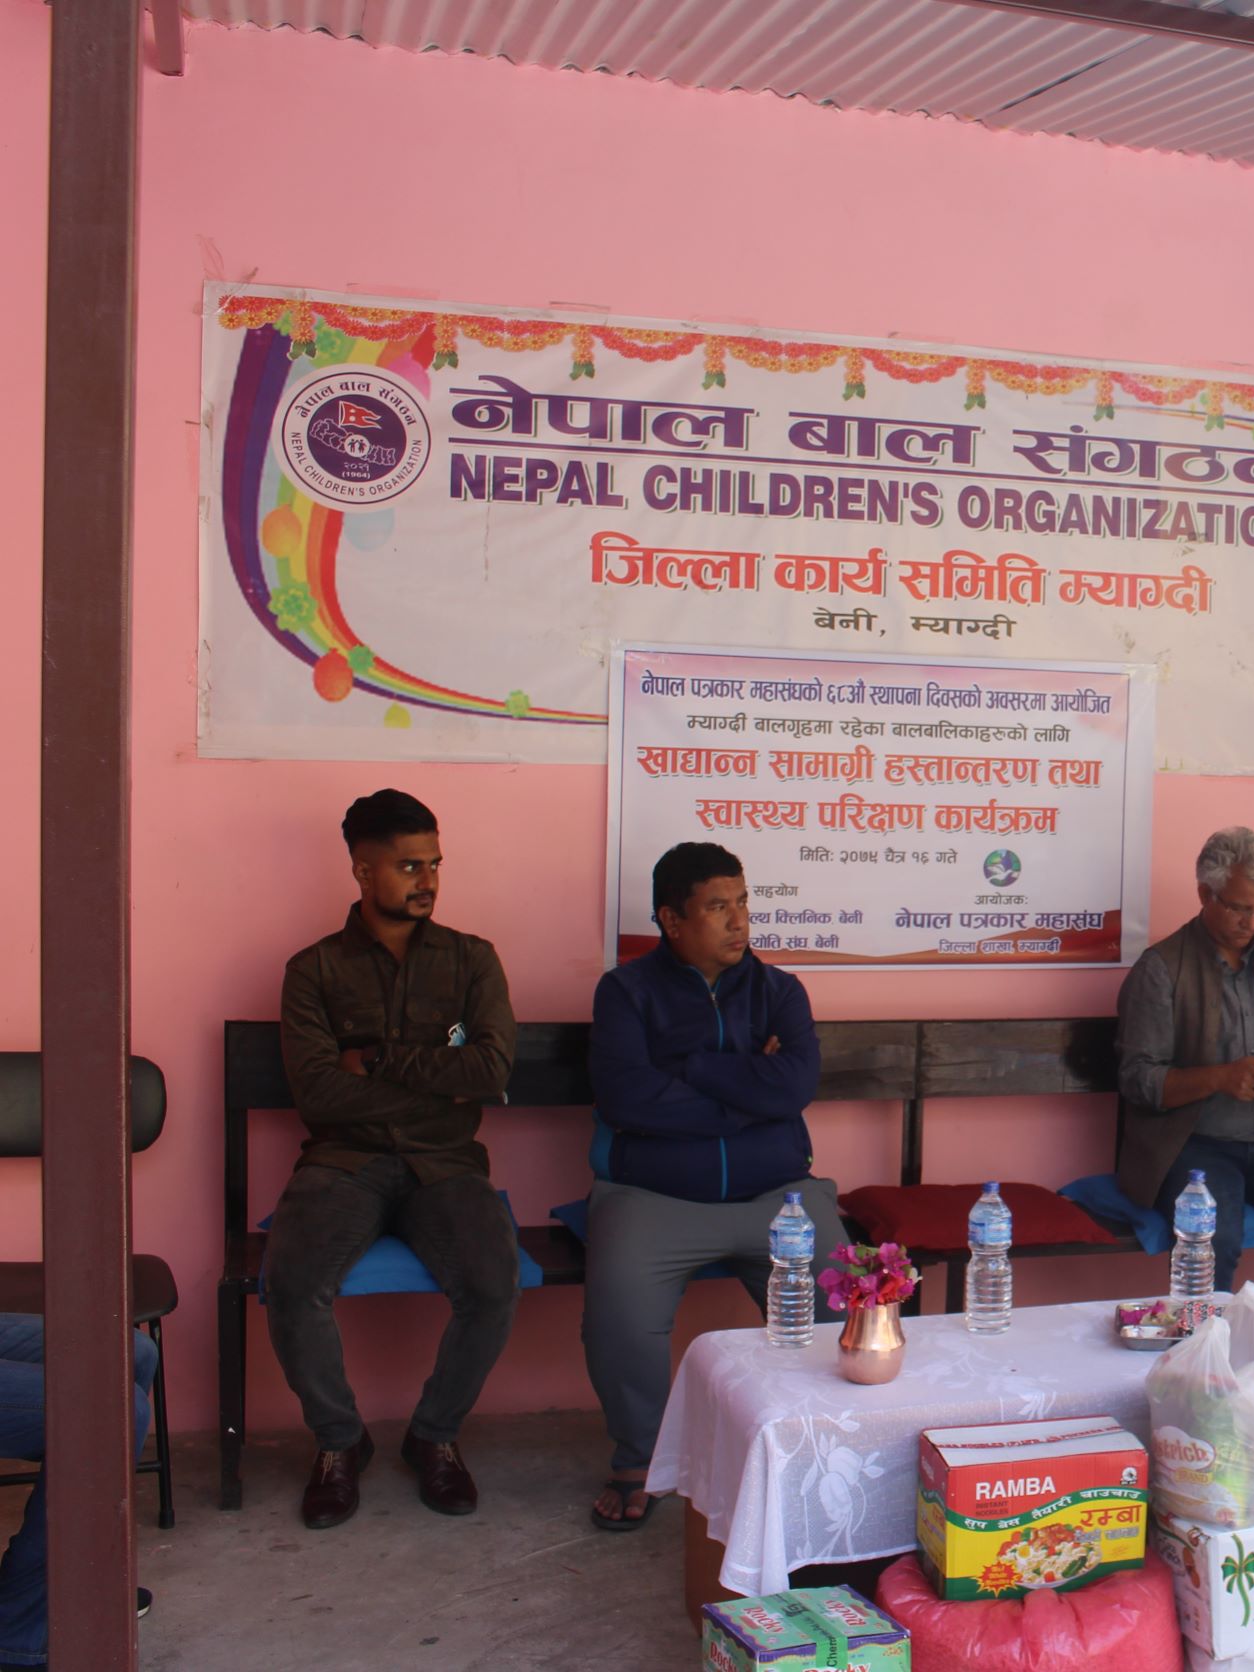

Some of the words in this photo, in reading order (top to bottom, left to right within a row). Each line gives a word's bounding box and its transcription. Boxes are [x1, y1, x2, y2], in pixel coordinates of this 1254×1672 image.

[449, 375, 754, 450] नेपाल
[788, 409, 982, 465] बाल
[291, 432, 306, 466] NEPAL
[304, 465, 366, 497] CHILDREN'S
[369, 439, 422, 496] ORGANIZATION
[342, 472, 371, 480] (1964)
[449, 452, 624, 509] NEPAL
[642, 464, 943, 528] CHILDREN'S
[590, 531, 761, 592] जिल्ला
[773, 547, 888, 599] कार्य
[899, 550, 1047, 607] समिति
[1058, 565, 1214, 614] म्याग्दी
[813, 607, 887, 637] बेनी,
[910, 614, 1017, 640] म्याग्दी
[641, 670, 685, 697] नेपाल
[691, 678, 746, 700] पत्रकार
[750, 677, 823, 702] महासंघको
[870, 685, 922, 706] स्थापना
[926, 682, 982, 709] दिवसको
[986, 690, 1047, 712] अवसरमा
[1051, 688, 1112, 714] आयोजित
[687, 713, 747, 733] म्याग्दी
[753, 717, 833, 738] बालगृहमा
[840, 717, 885, 738] रहेका
[1034, 724, 1072, 743] लागि
[637, 746, 759, 778] खाद्यान्न
[769, 744, 876, 784] सामाग्री
[884, 754, 1040, 786] हस्तान्तरण
[1048, 759, 1103, 788] तथा
[696, 799, 808, 831] स्वास्थ्य
[817, 793, 926, 835] परिक्षण
[935, 798, 1060, 835] कार्यक्रम
[884, 847, 906, 863] चैत्र
[911, 851, 930, 864] १६
[935, 848, 958, 864] गते
[753, 883, 798, 898] सहयोग
[839, 909, 864, 924] बेनी
[895, 908, 952, 929] नेपाल
[959, 912, 1028, 930] पत्रकार
[1035, 909, 1103, 930] महासंघ
[815, 934, 840, 948] बेनी
[939, 938, 976, 953] जिल्ला
[1019, 938, 1060, 953] म्याग्दी
[975, 1476, 1056, 1500] RAMBA
[1080, 1504, 1142, 1527] रम्बा
